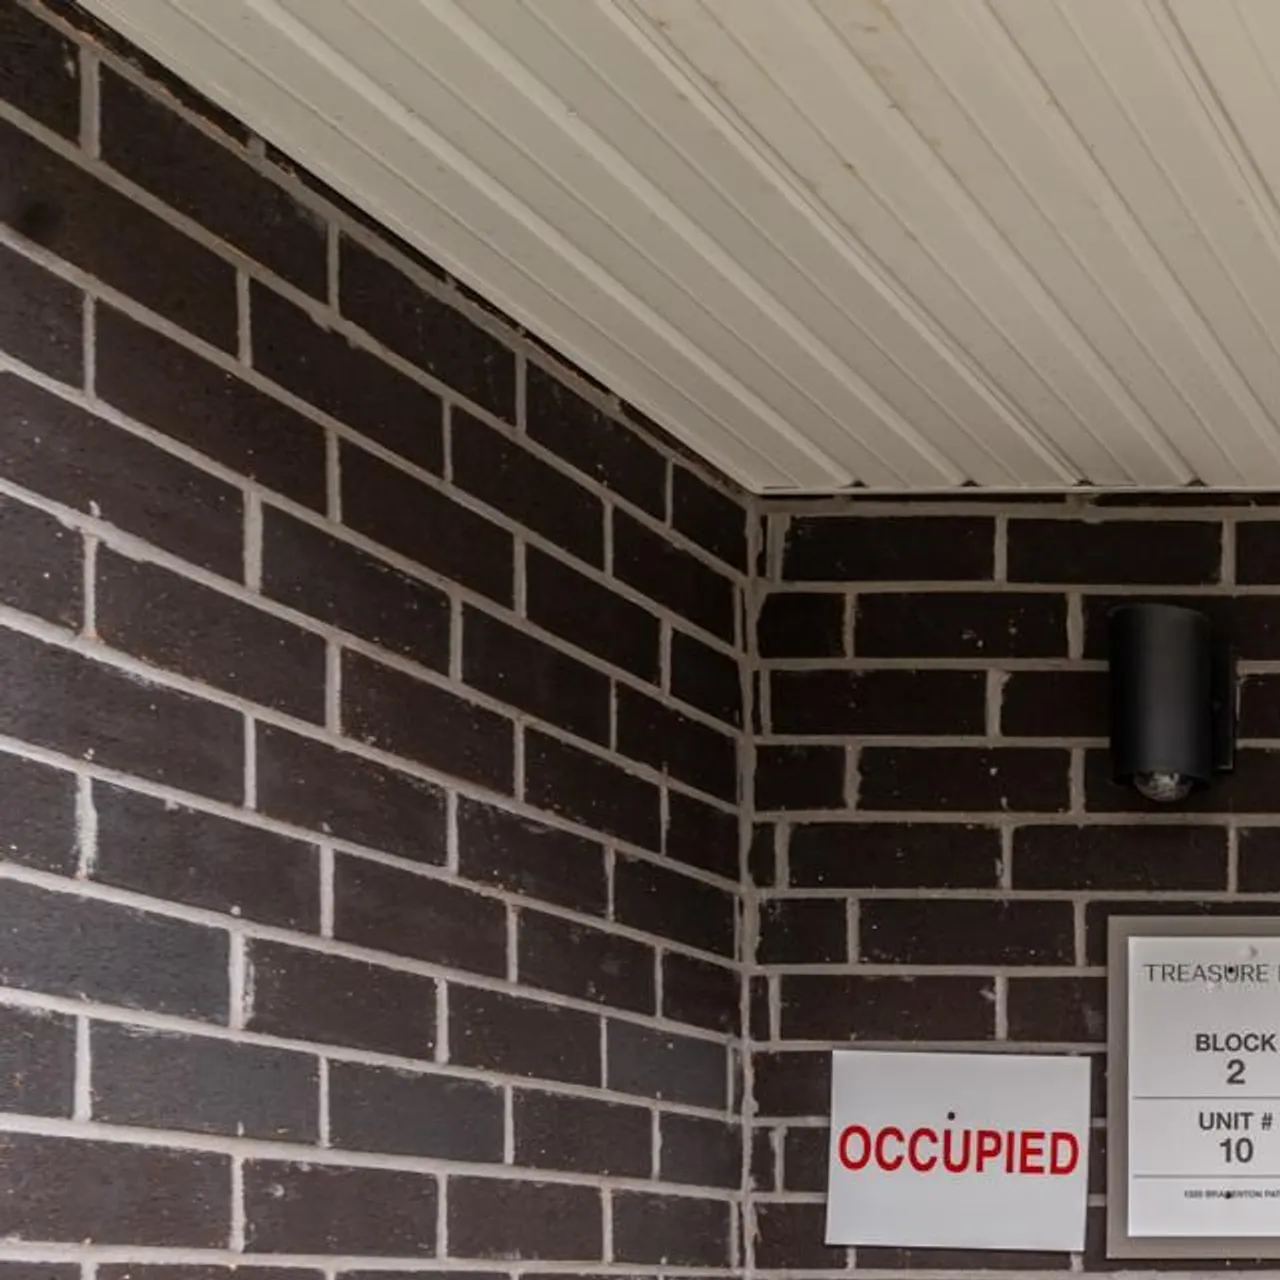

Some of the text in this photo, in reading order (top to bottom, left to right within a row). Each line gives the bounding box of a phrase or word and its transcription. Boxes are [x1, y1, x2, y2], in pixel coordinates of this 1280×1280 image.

[1143, 963, 1270, 983] TREASURE
[1195, 1033, 1277, 1053] BLOCK
[1226, 1058, 1246, 1085] 2
[1199, 1111, 1273, 1131] UNIT #
[838, 1125, 1080, 1175] OCCUPIED
[1219, 1137, 1254, 1164] 10
